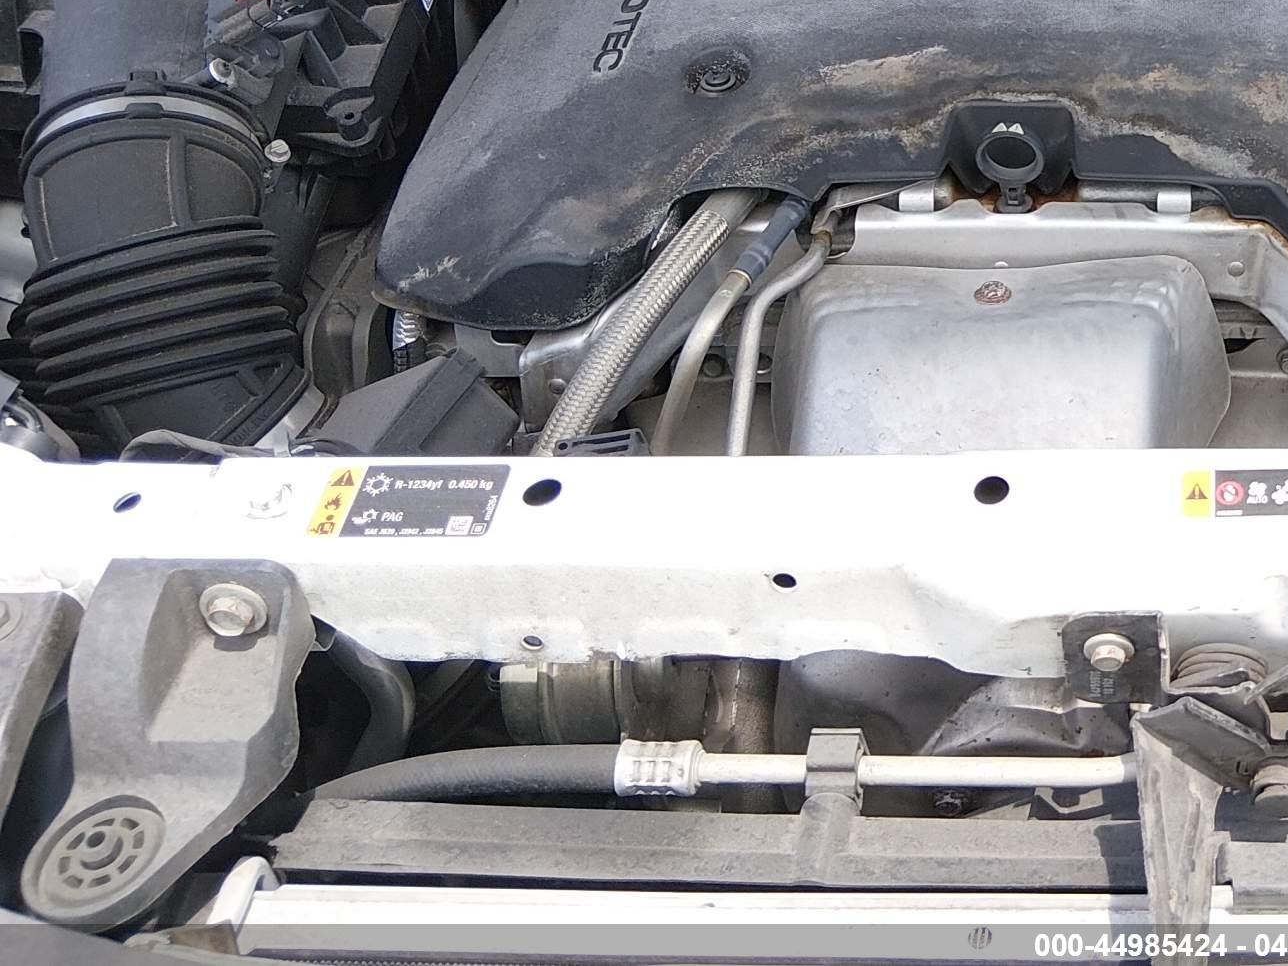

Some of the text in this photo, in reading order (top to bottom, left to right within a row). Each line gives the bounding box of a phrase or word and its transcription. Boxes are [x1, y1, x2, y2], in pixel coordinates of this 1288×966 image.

[448, 479, 478, 490] 0.450
[479, 480, 494, 491] kg
[381, 511, 404, 522] PAG
